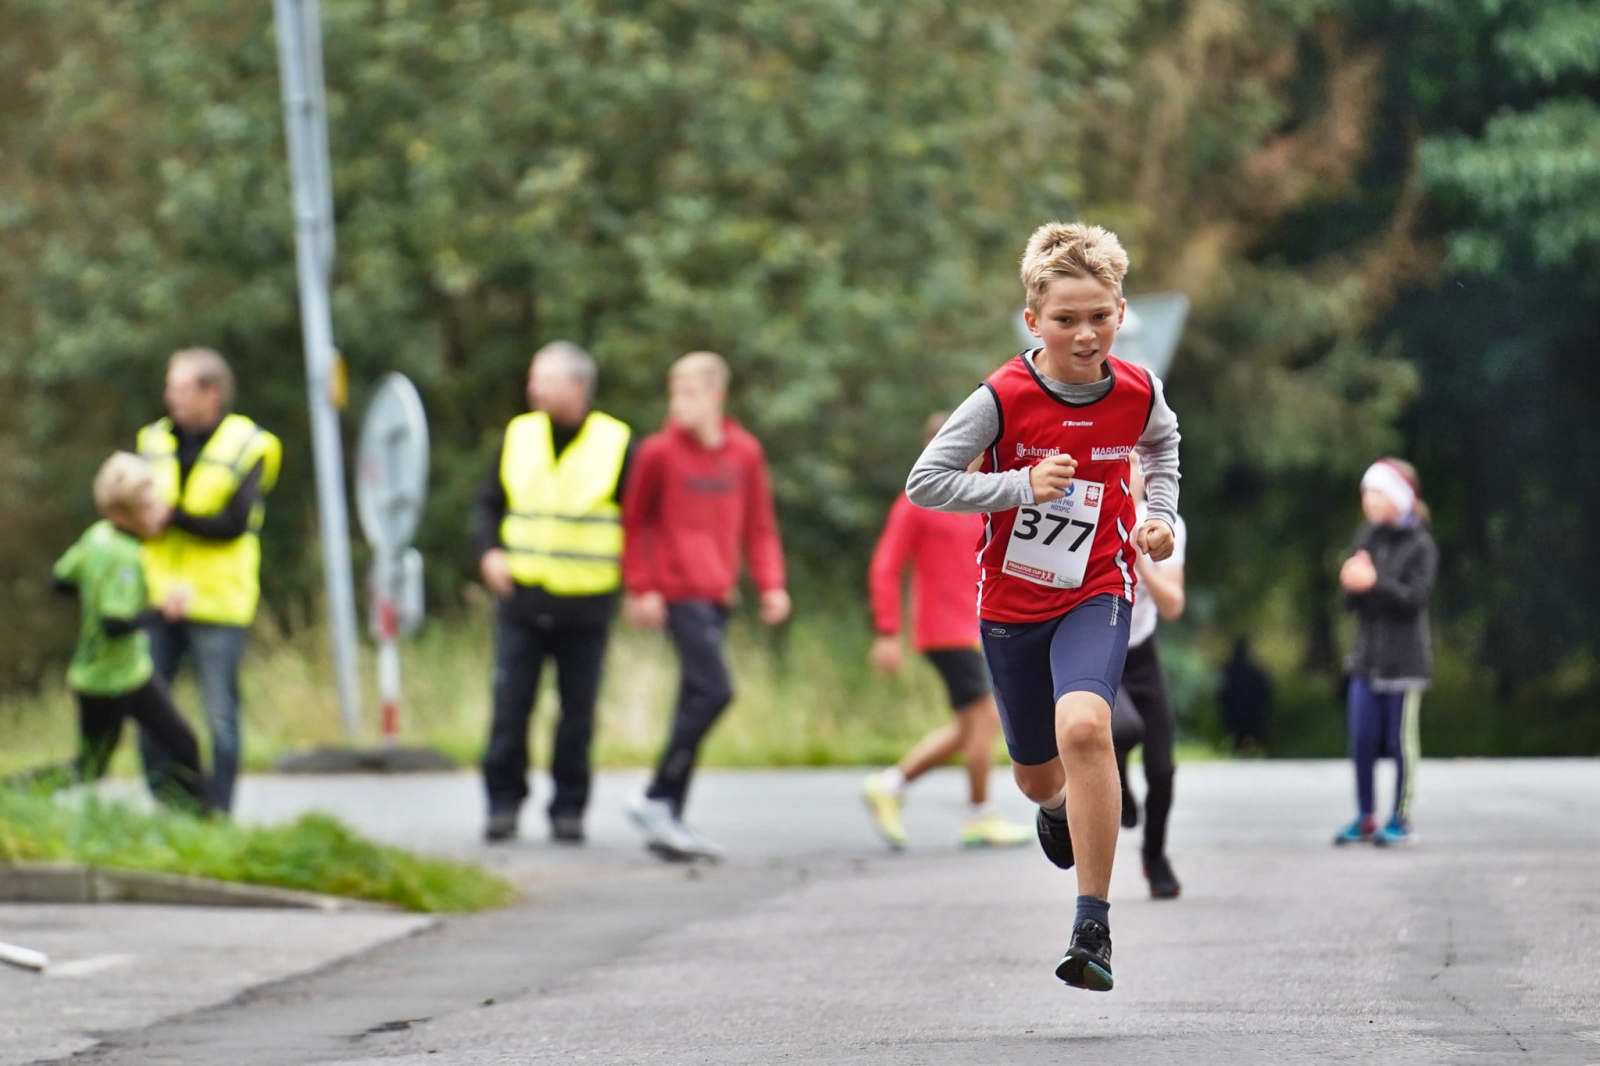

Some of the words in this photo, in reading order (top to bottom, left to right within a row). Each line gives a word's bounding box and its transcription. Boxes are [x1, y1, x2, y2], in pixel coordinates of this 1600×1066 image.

[1091, 445, 1132, 455] MARATON
[1062, 499, 1074, 507] PRO
[1050, 504, 1071, 514] HOSPIC
[1013, 508, 1095, 553] 377
